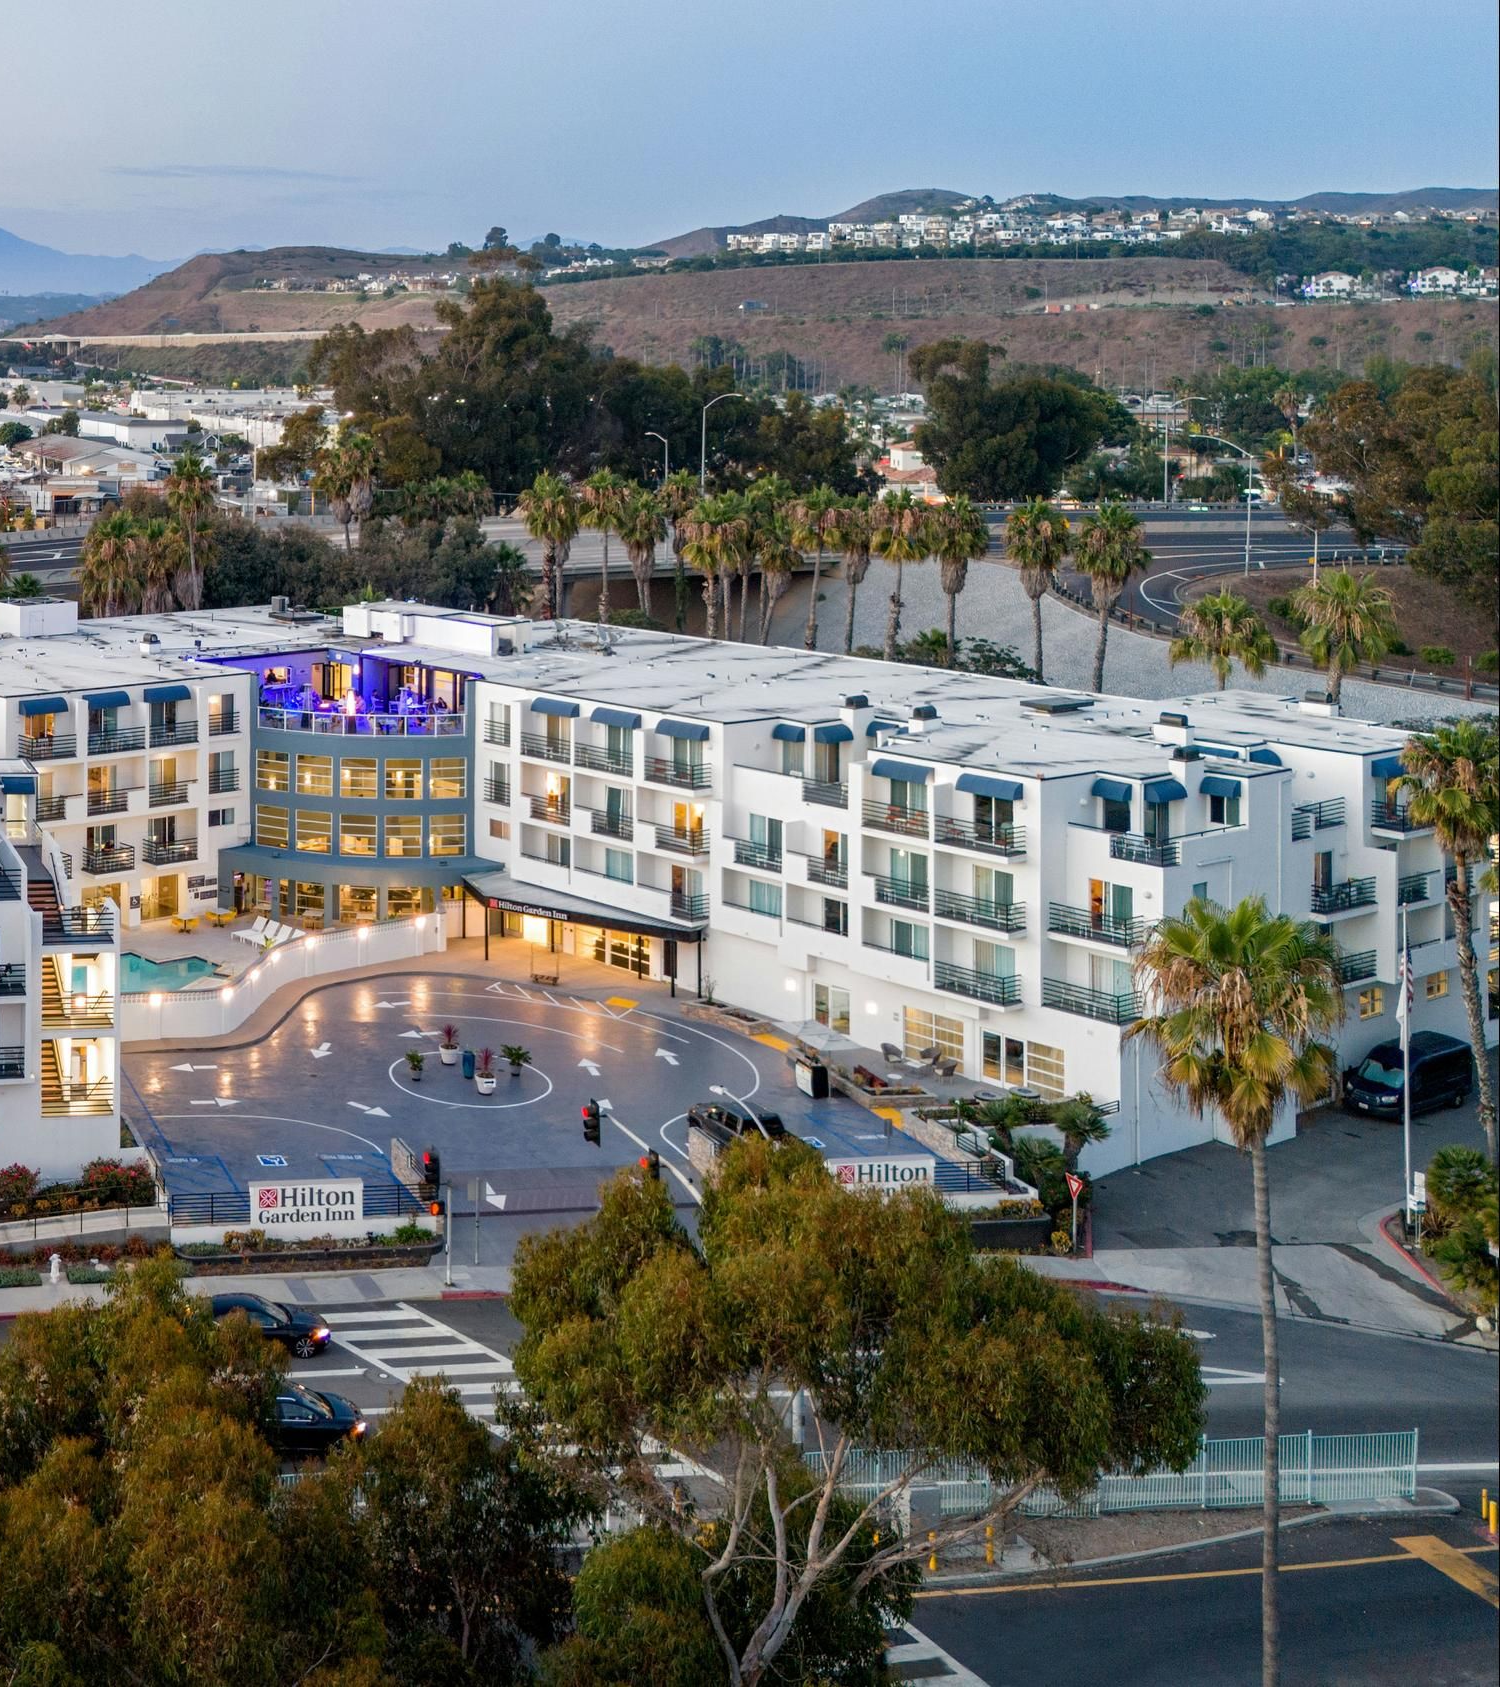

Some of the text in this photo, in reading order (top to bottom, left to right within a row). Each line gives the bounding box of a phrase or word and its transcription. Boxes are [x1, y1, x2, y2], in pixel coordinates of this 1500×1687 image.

[498, 901, 567, 920] Hilton Garden Inn
[857, 1163, 928, 1183] Hilton
[280, 1187, 355, 1208] Hilton
[258, 1207, 356, 1225] Garden Inn
